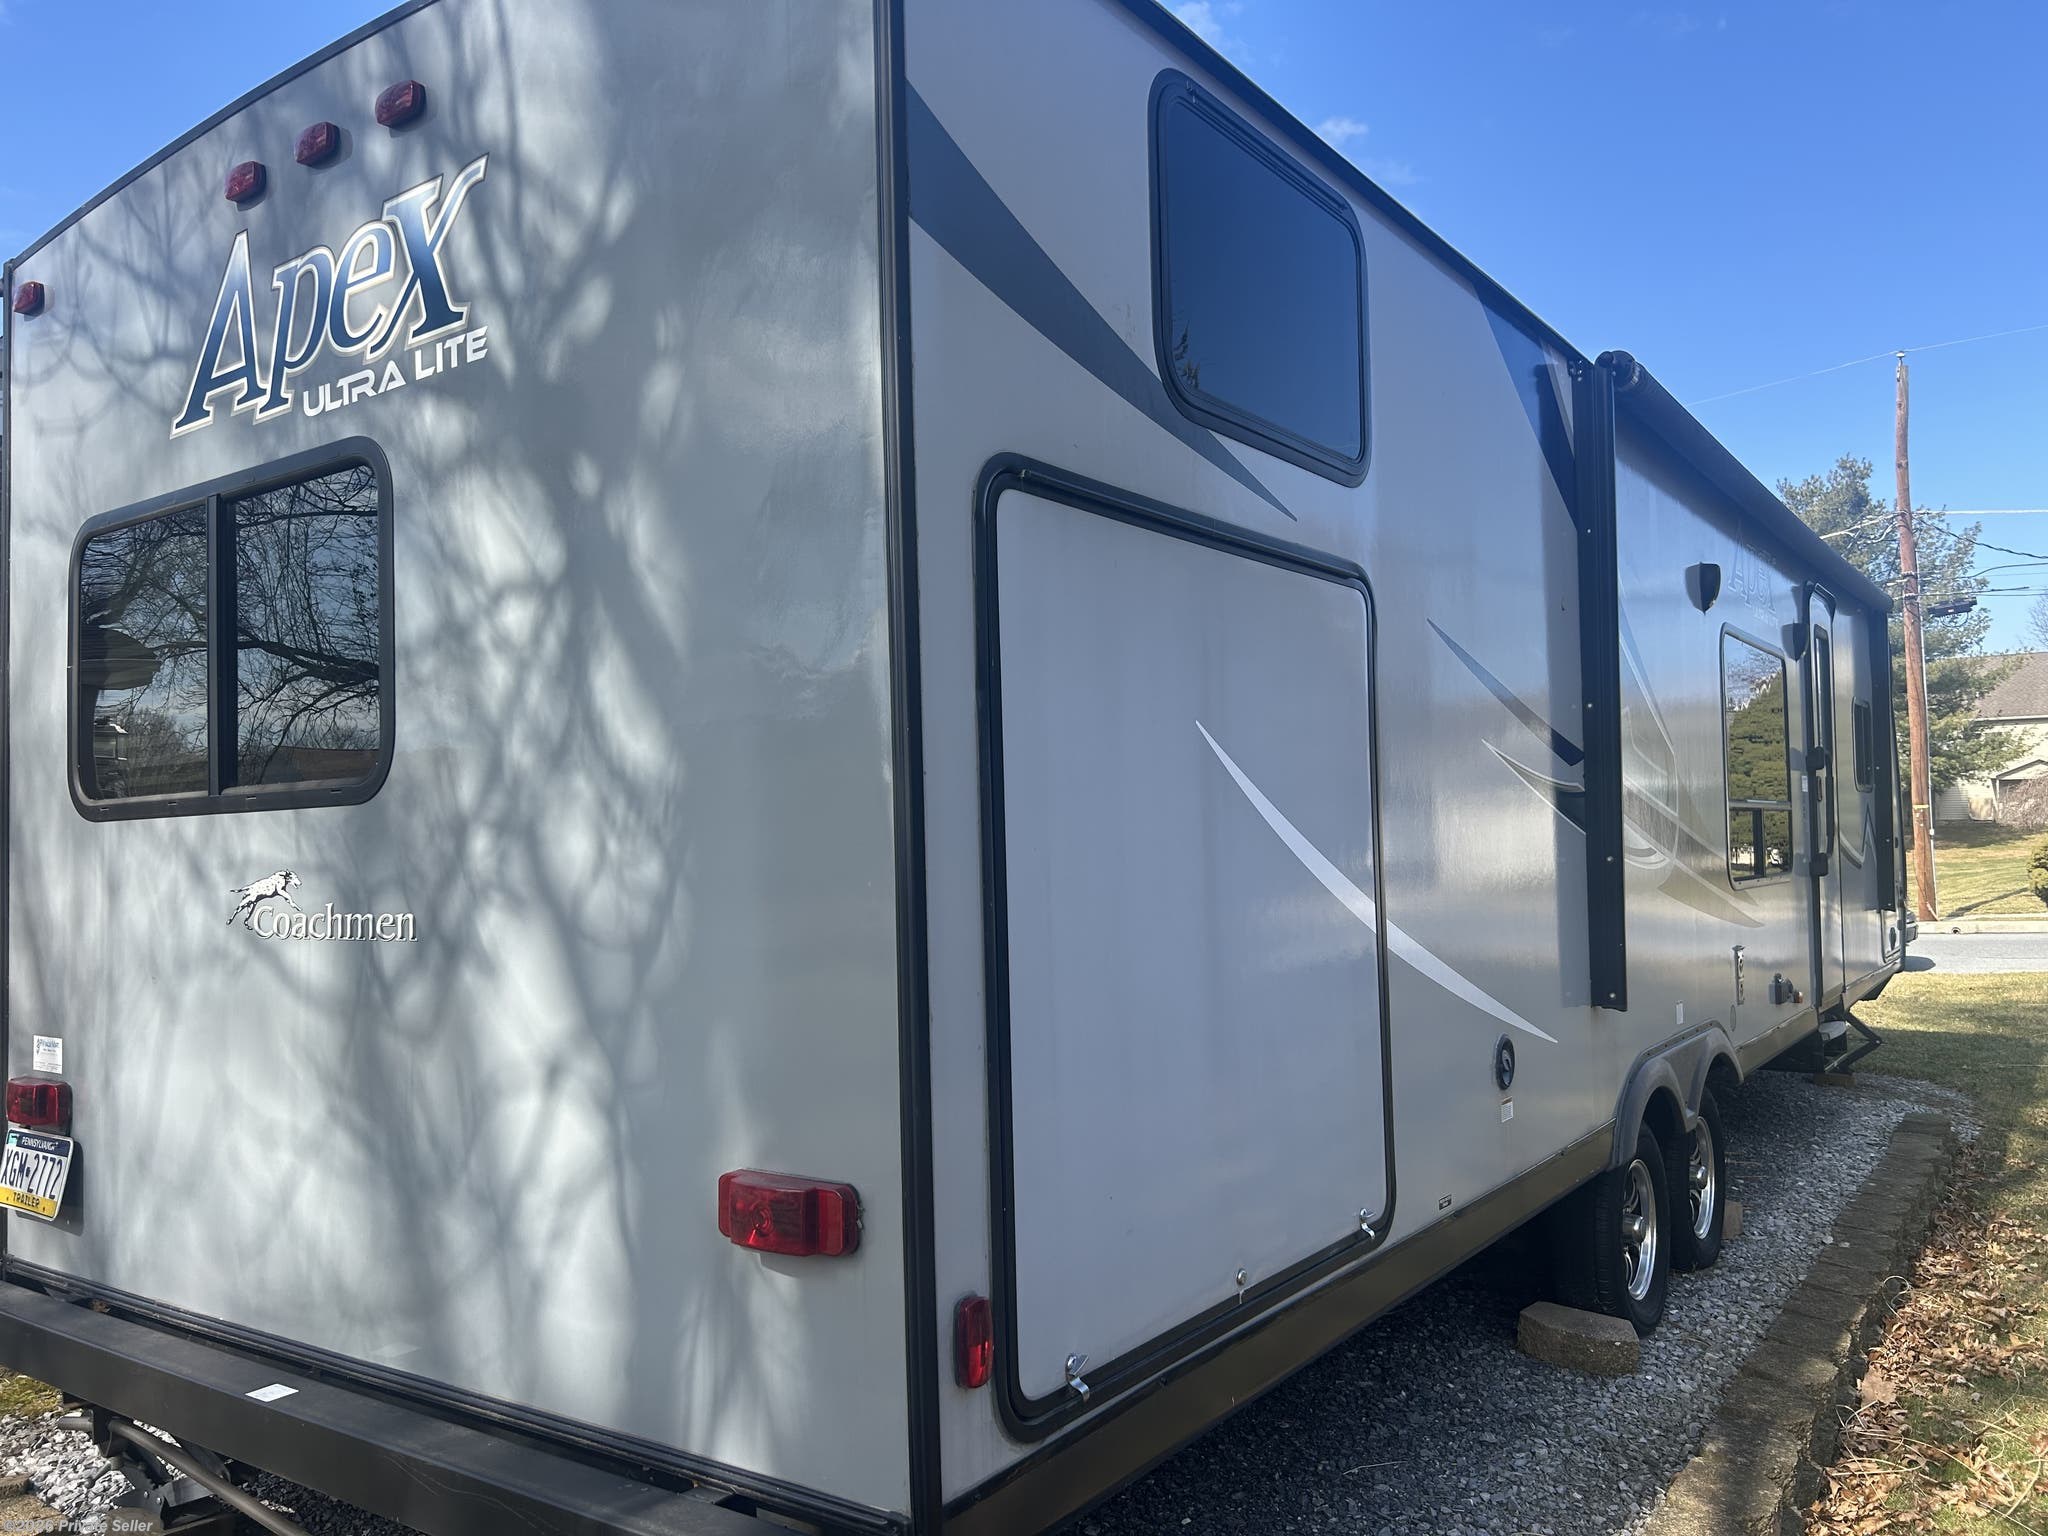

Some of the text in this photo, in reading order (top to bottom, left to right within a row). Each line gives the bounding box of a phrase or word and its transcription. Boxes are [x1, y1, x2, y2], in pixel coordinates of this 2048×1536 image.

[303, 325, 488, 417] ULTRA LITE
[253, 903, 418, 941] Coachmen
[13, 1191, 40, 1209] TRAILER
